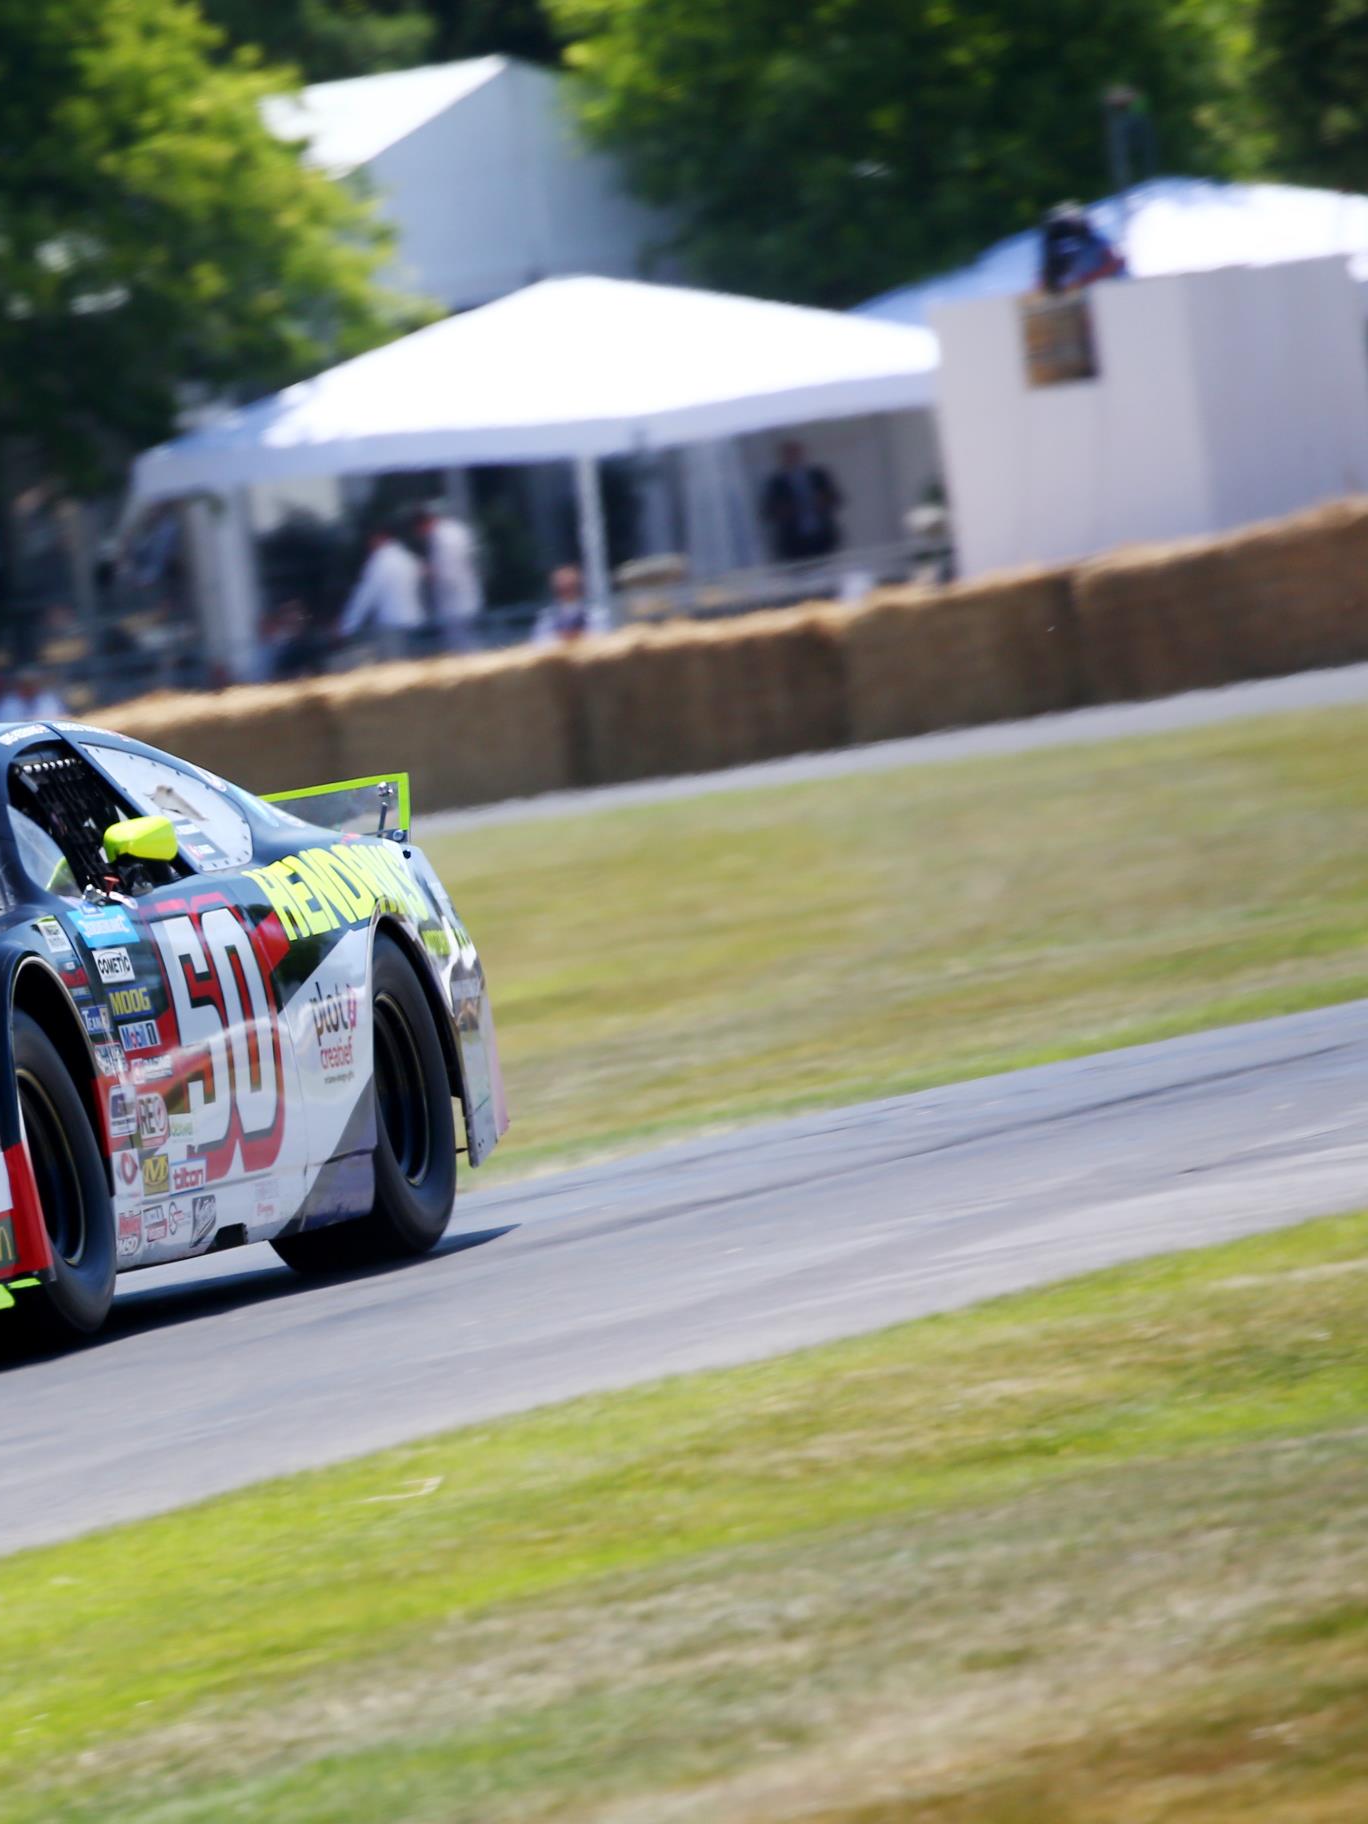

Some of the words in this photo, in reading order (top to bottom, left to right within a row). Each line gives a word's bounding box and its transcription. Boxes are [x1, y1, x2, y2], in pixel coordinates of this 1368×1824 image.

[96, 953, 131, 975] COMETIC
[109, 986, 152, 1016] MOOG
[150, 907, 280, 1152] 50
